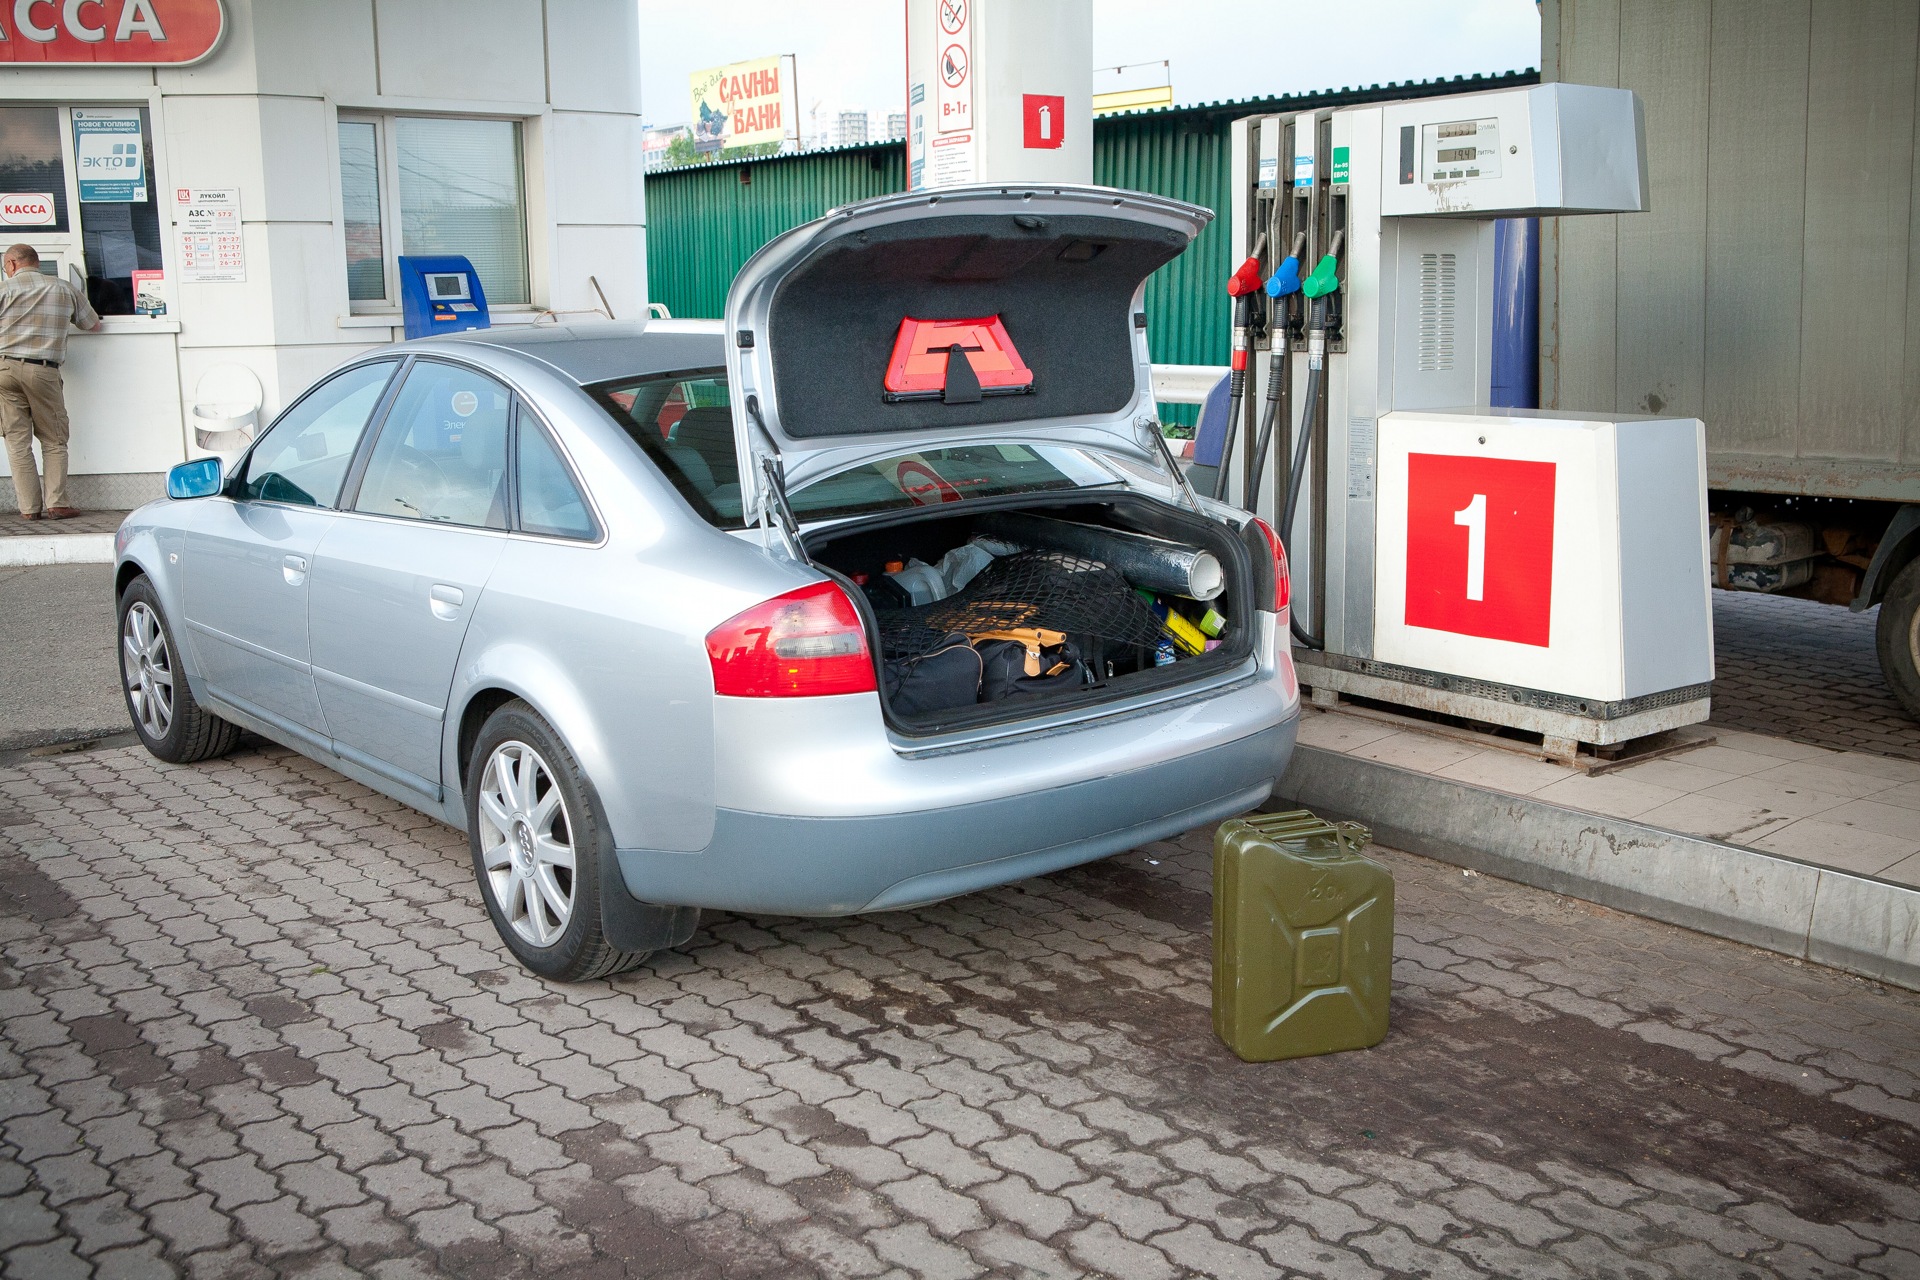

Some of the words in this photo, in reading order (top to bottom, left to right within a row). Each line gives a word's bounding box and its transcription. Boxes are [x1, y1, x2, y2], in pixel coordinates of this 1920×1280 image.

[0, 0, 168, 43] ССА
[719, 67, 779, 103] САУНЫ
[734, 102, 780, 134] БАНИ
[943, 101, 967, 116] В-1г
[83, 157, 123, 168] ЭКТО
[5, 204, 47, 214] КАССА
[189, 209, 205, 217] АЗС
[1454, 494, 1487, 601] 1
